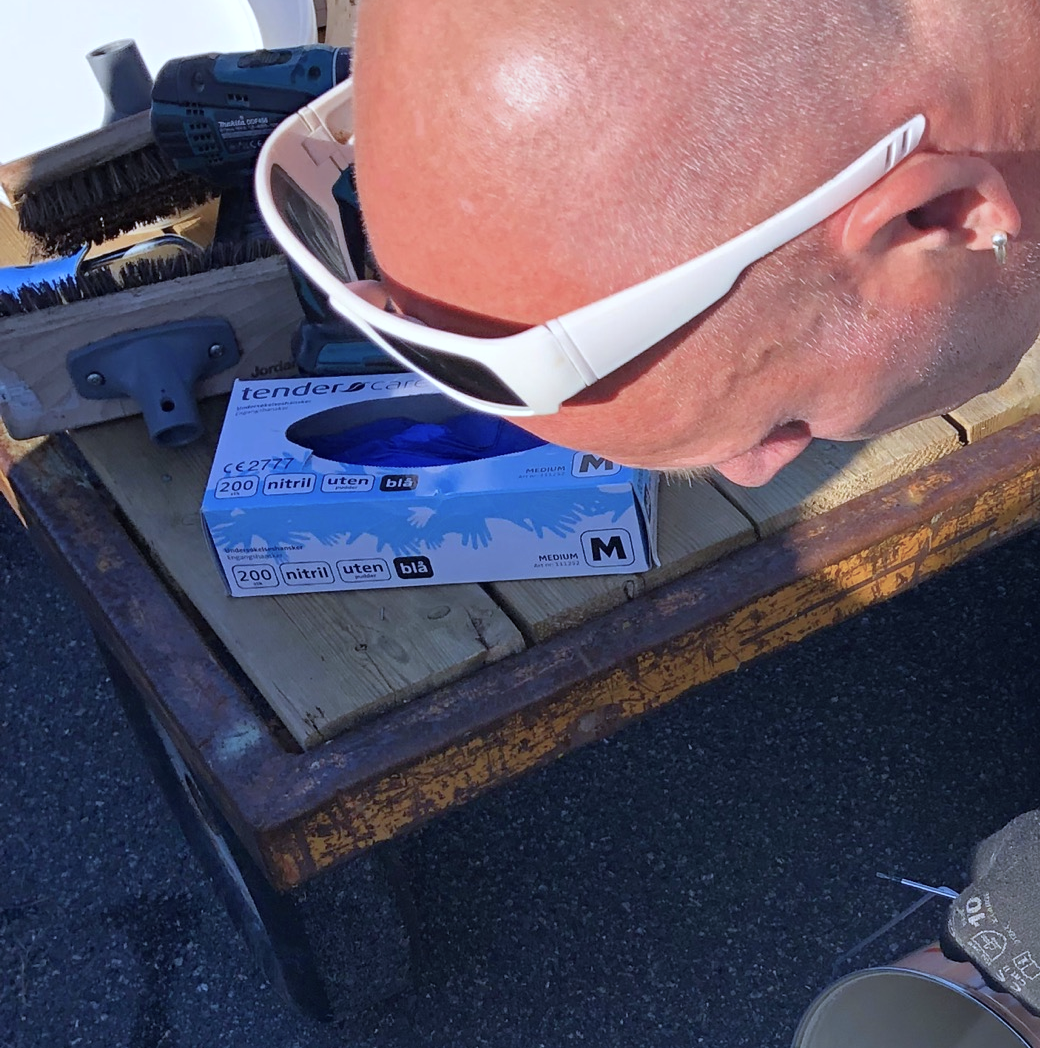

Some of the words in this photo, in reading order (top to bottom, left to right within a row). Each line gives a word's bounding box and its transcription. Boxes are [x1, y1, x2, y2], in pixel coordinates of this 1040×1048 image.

[241, 381, 344, 401] tender
[370, 379, 427, 391] care
[525, 466, 566, 475] MEDIUM
[579, 453, 614, 474] M
[220, 480, 254, 493] 200
[267, 477, 312, 491] nitril
[327, 475, 370, 487] uten
[385, 475, 414, 488] blå
[538, 552, 579, 562] MEDIUM
[590, 536, 627, 562] M
[237, 570, 273, 583] 200
[285, 566, 331, 581] nitril
[342, 562, 385, 576] uten
[400, 561, 429, 574] blå
[966, 896, 986, 928] 10
